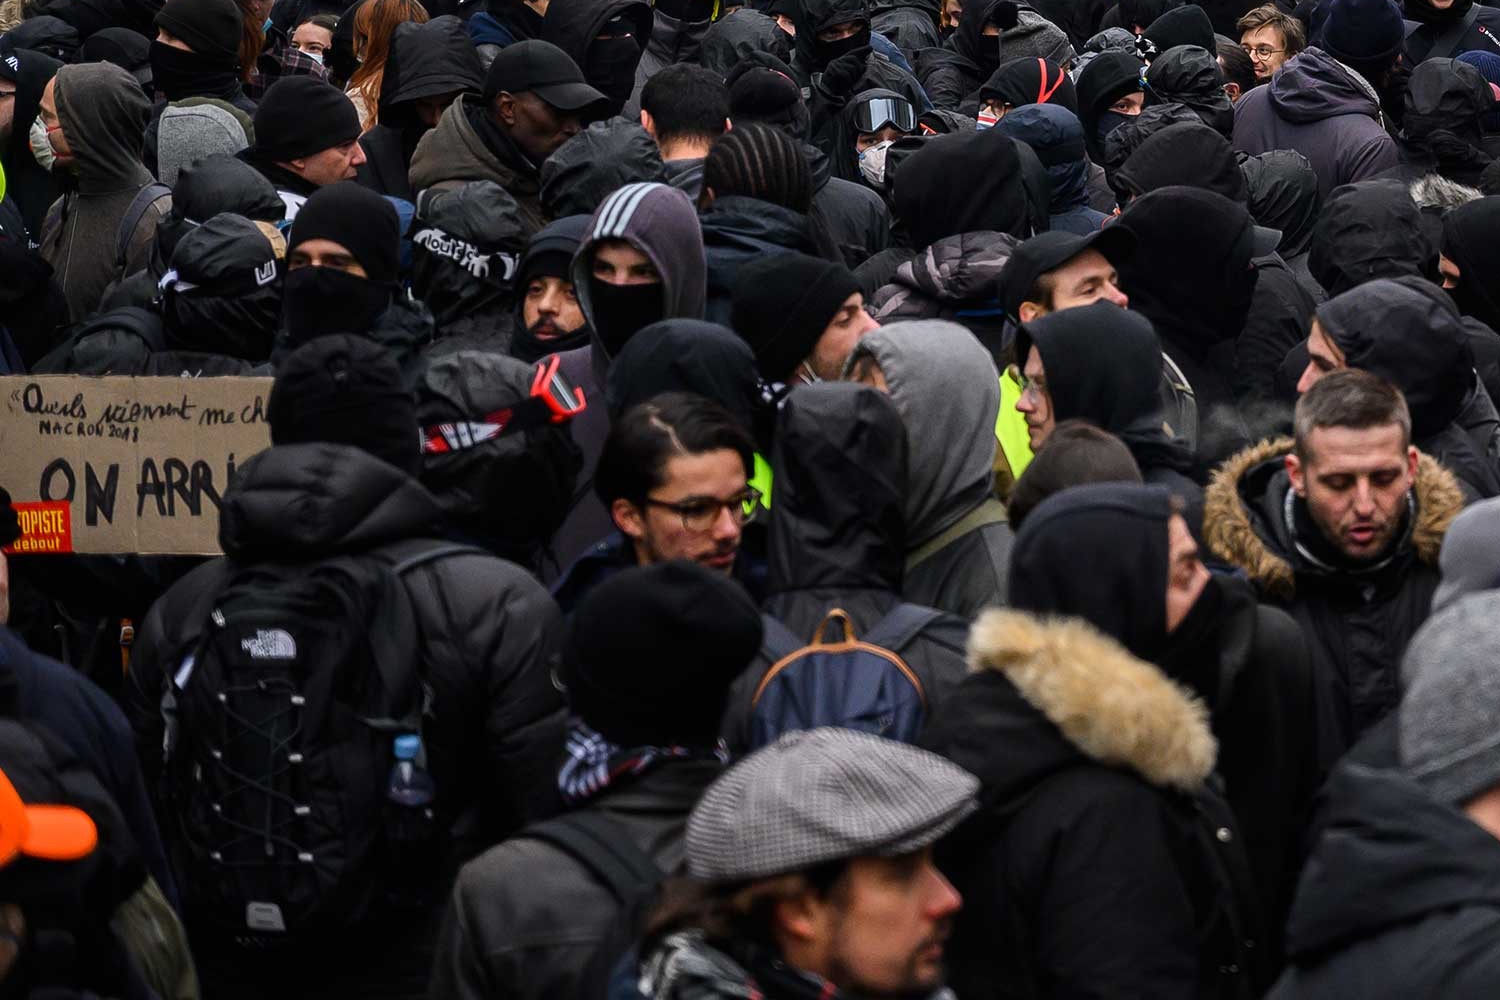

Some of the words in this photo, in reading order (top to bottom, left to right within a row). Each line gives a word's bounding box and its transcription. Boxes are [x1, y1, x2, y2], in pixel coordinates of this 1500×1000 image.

[199, 408, 235, 424] me
[39, 457, 119, 526] ON
[17, 510, 65, 534] TOPISTE
